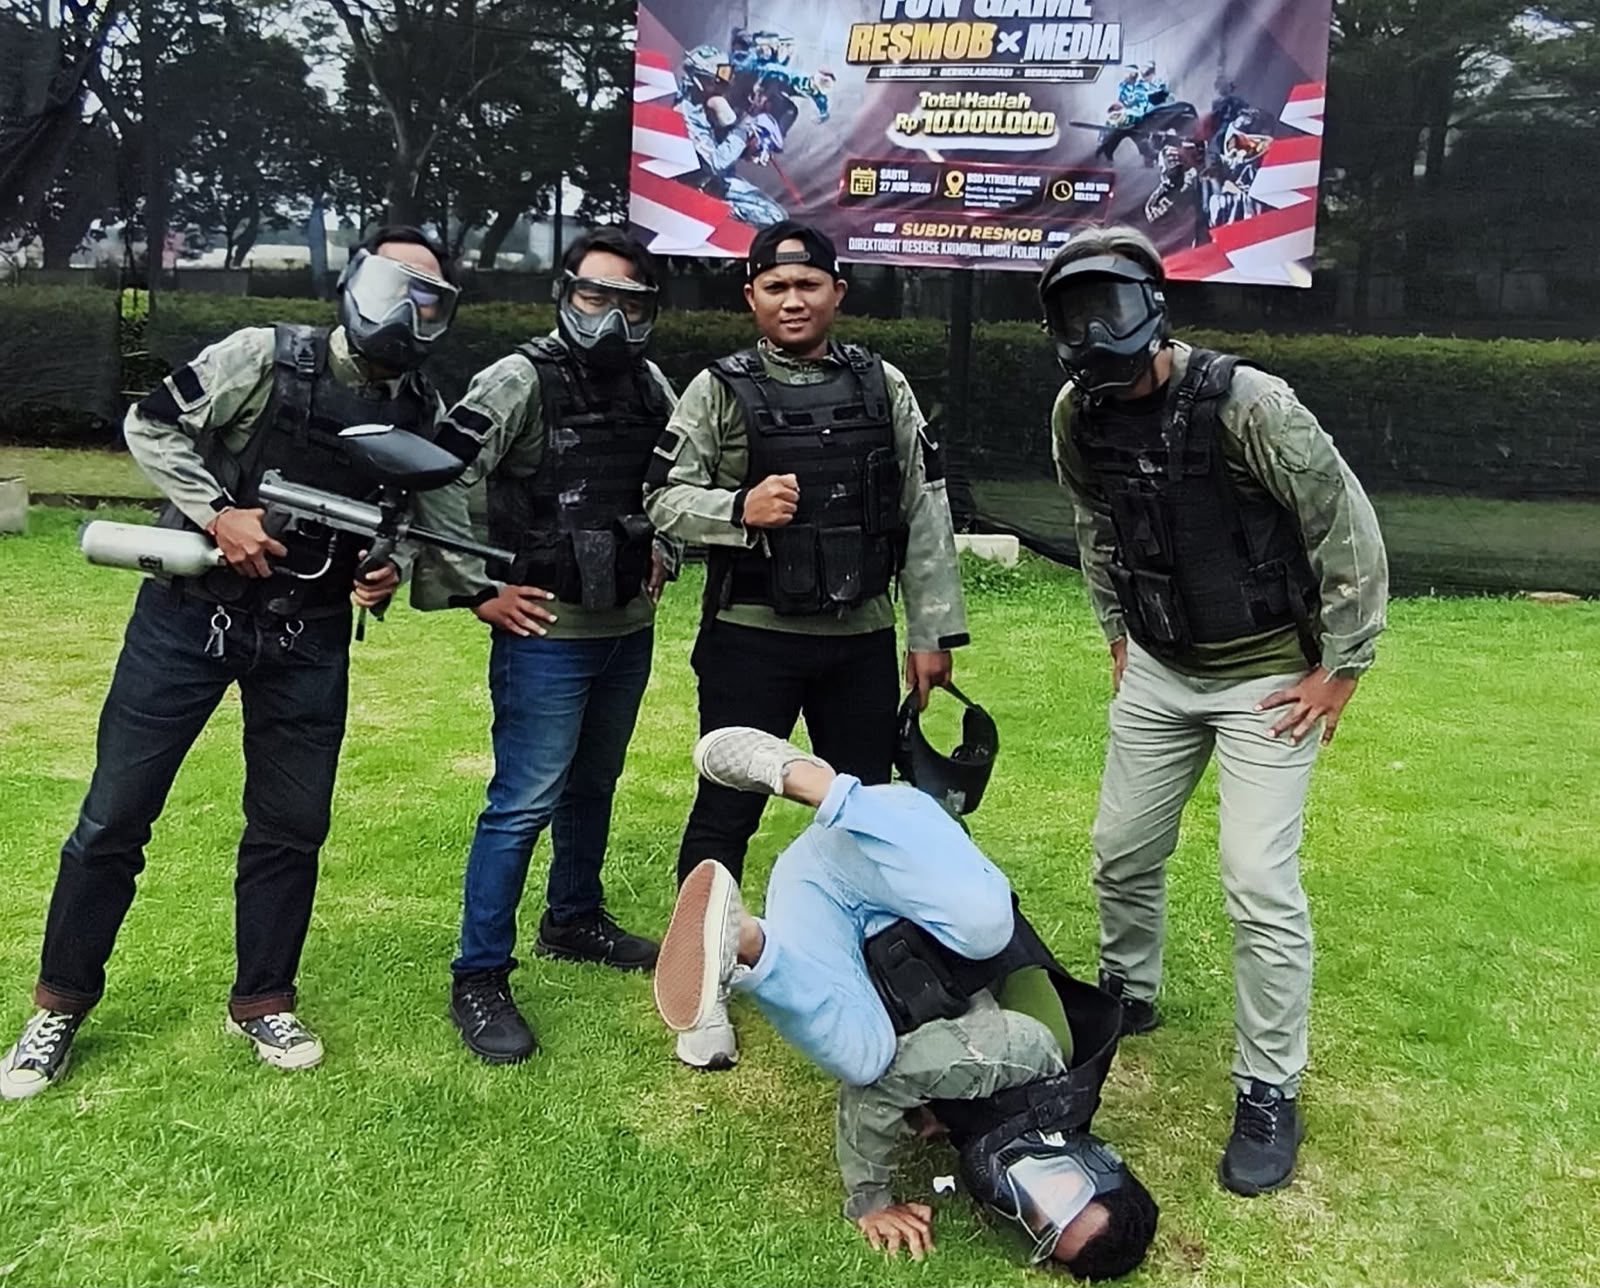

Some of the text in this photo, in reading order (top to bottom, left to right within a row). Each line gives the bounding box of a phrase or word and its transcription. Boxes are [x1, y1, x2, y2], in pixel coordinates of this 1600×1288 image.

[848, 22, 997, 61] RESMOB
[1023, 23, 1120, 61] MEDIA
[919, 91, 1032, 110] Total Hadiah
[895, 109, 1056, 135] Rp 10.000.000
[879, 181, 891, 192] 27
[1018, 176, 1041, 187] PARK
[901, 222, 1043, 242] SUBDIT RESMOB
[848, 237, 901, 252] DIREKTORAT
[902, 239, 940, 254] RESERSE
